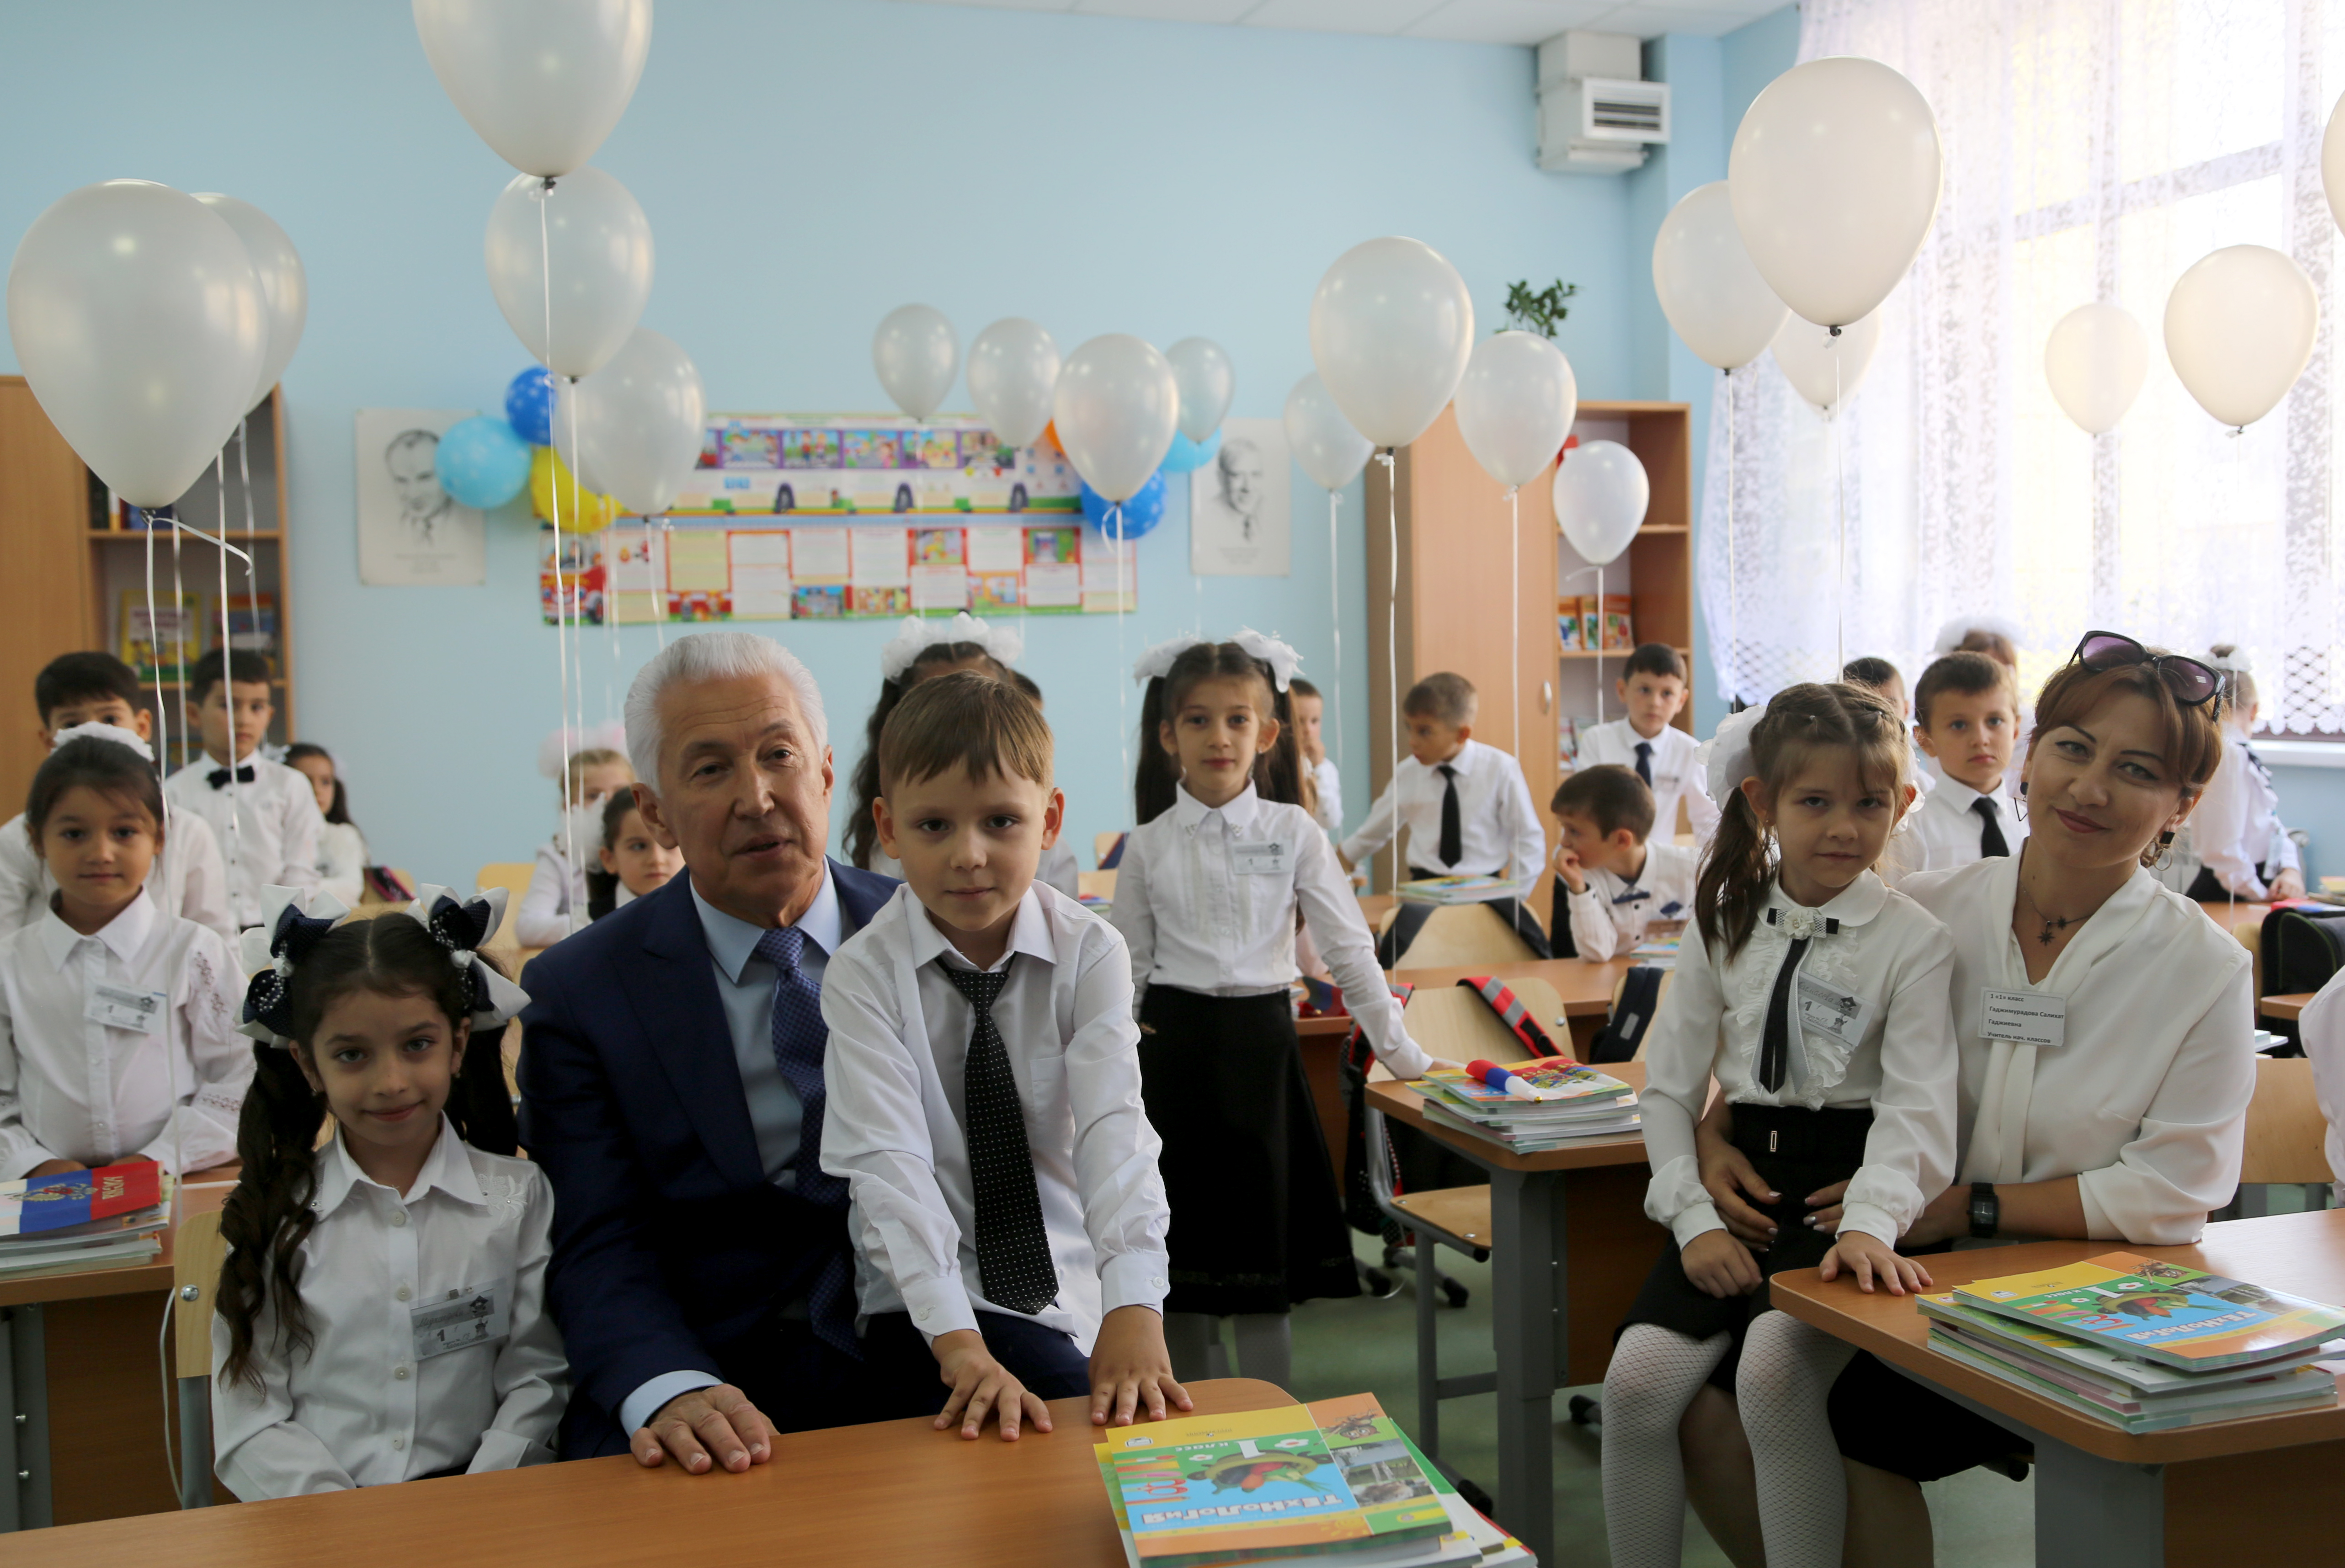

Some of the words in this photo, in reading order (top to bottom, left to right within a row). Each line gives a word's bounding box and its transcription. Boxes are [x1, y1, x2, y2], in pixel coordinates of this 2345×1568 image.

[1805, 1001, 1812, 1011] 1
[1989, 1006, 2038, 1016] Гаджимурадова
[2044, 1289, 2082, 1298] класс
[437, 1329, 445, 1342] 1
[1174, 1441, 1229, 1452] класс
[1236, 1439, 1266, 1459] 1
